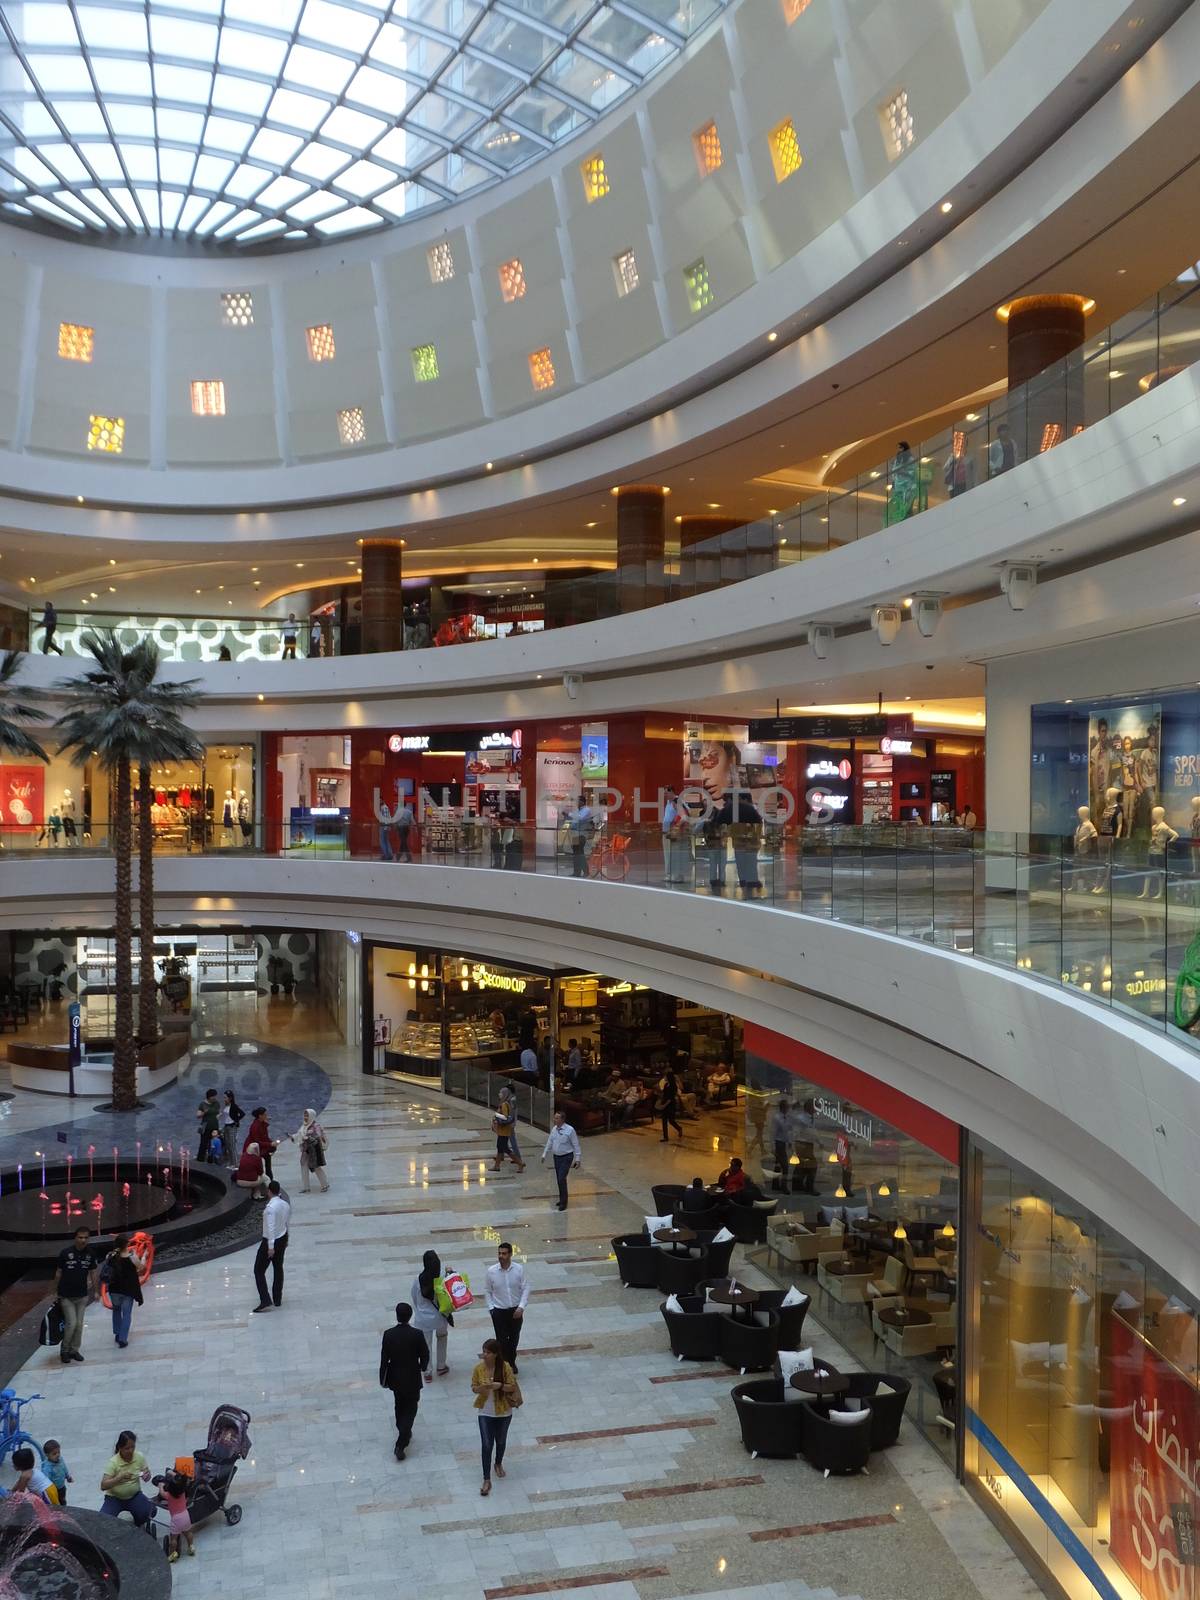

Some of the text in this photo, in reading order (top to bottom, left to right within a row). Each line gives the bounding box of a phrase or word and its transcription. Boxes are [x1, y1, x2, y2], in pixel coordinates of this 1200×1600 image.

[543, 758, 575, 766] lenovo
[483, 972, 526, 994] SECOND CUP
